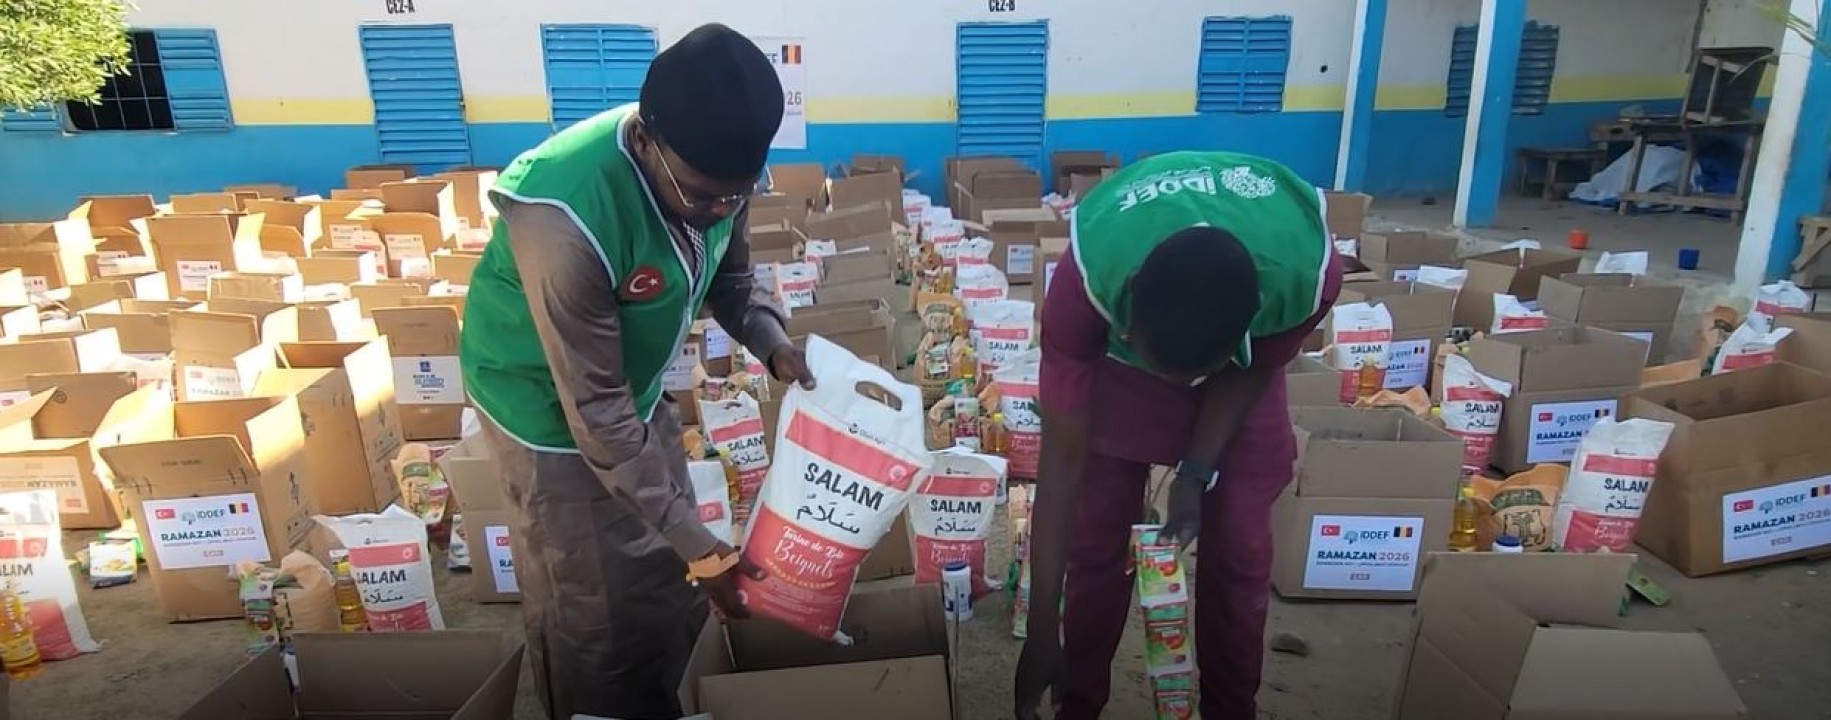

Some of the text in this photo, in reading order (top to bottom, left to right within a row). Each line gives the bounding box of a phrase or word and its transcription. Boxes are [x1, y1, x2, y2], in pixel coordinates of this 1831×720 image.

[1536, 430, 1583, 441] RAMAZAN
[804, 462, 884, 511] SALAM
[930, 499, 982, 514] SALAM
[1734, 514, 1796, 535] RAMAZAN
[1798, 507, 1831, 522] 2026
[160, 528, 222, 542] RAMAZAN
[222, 526, 255, 538] 2026
[1317, 549, 1410, 562] RAMAZAN 2026
